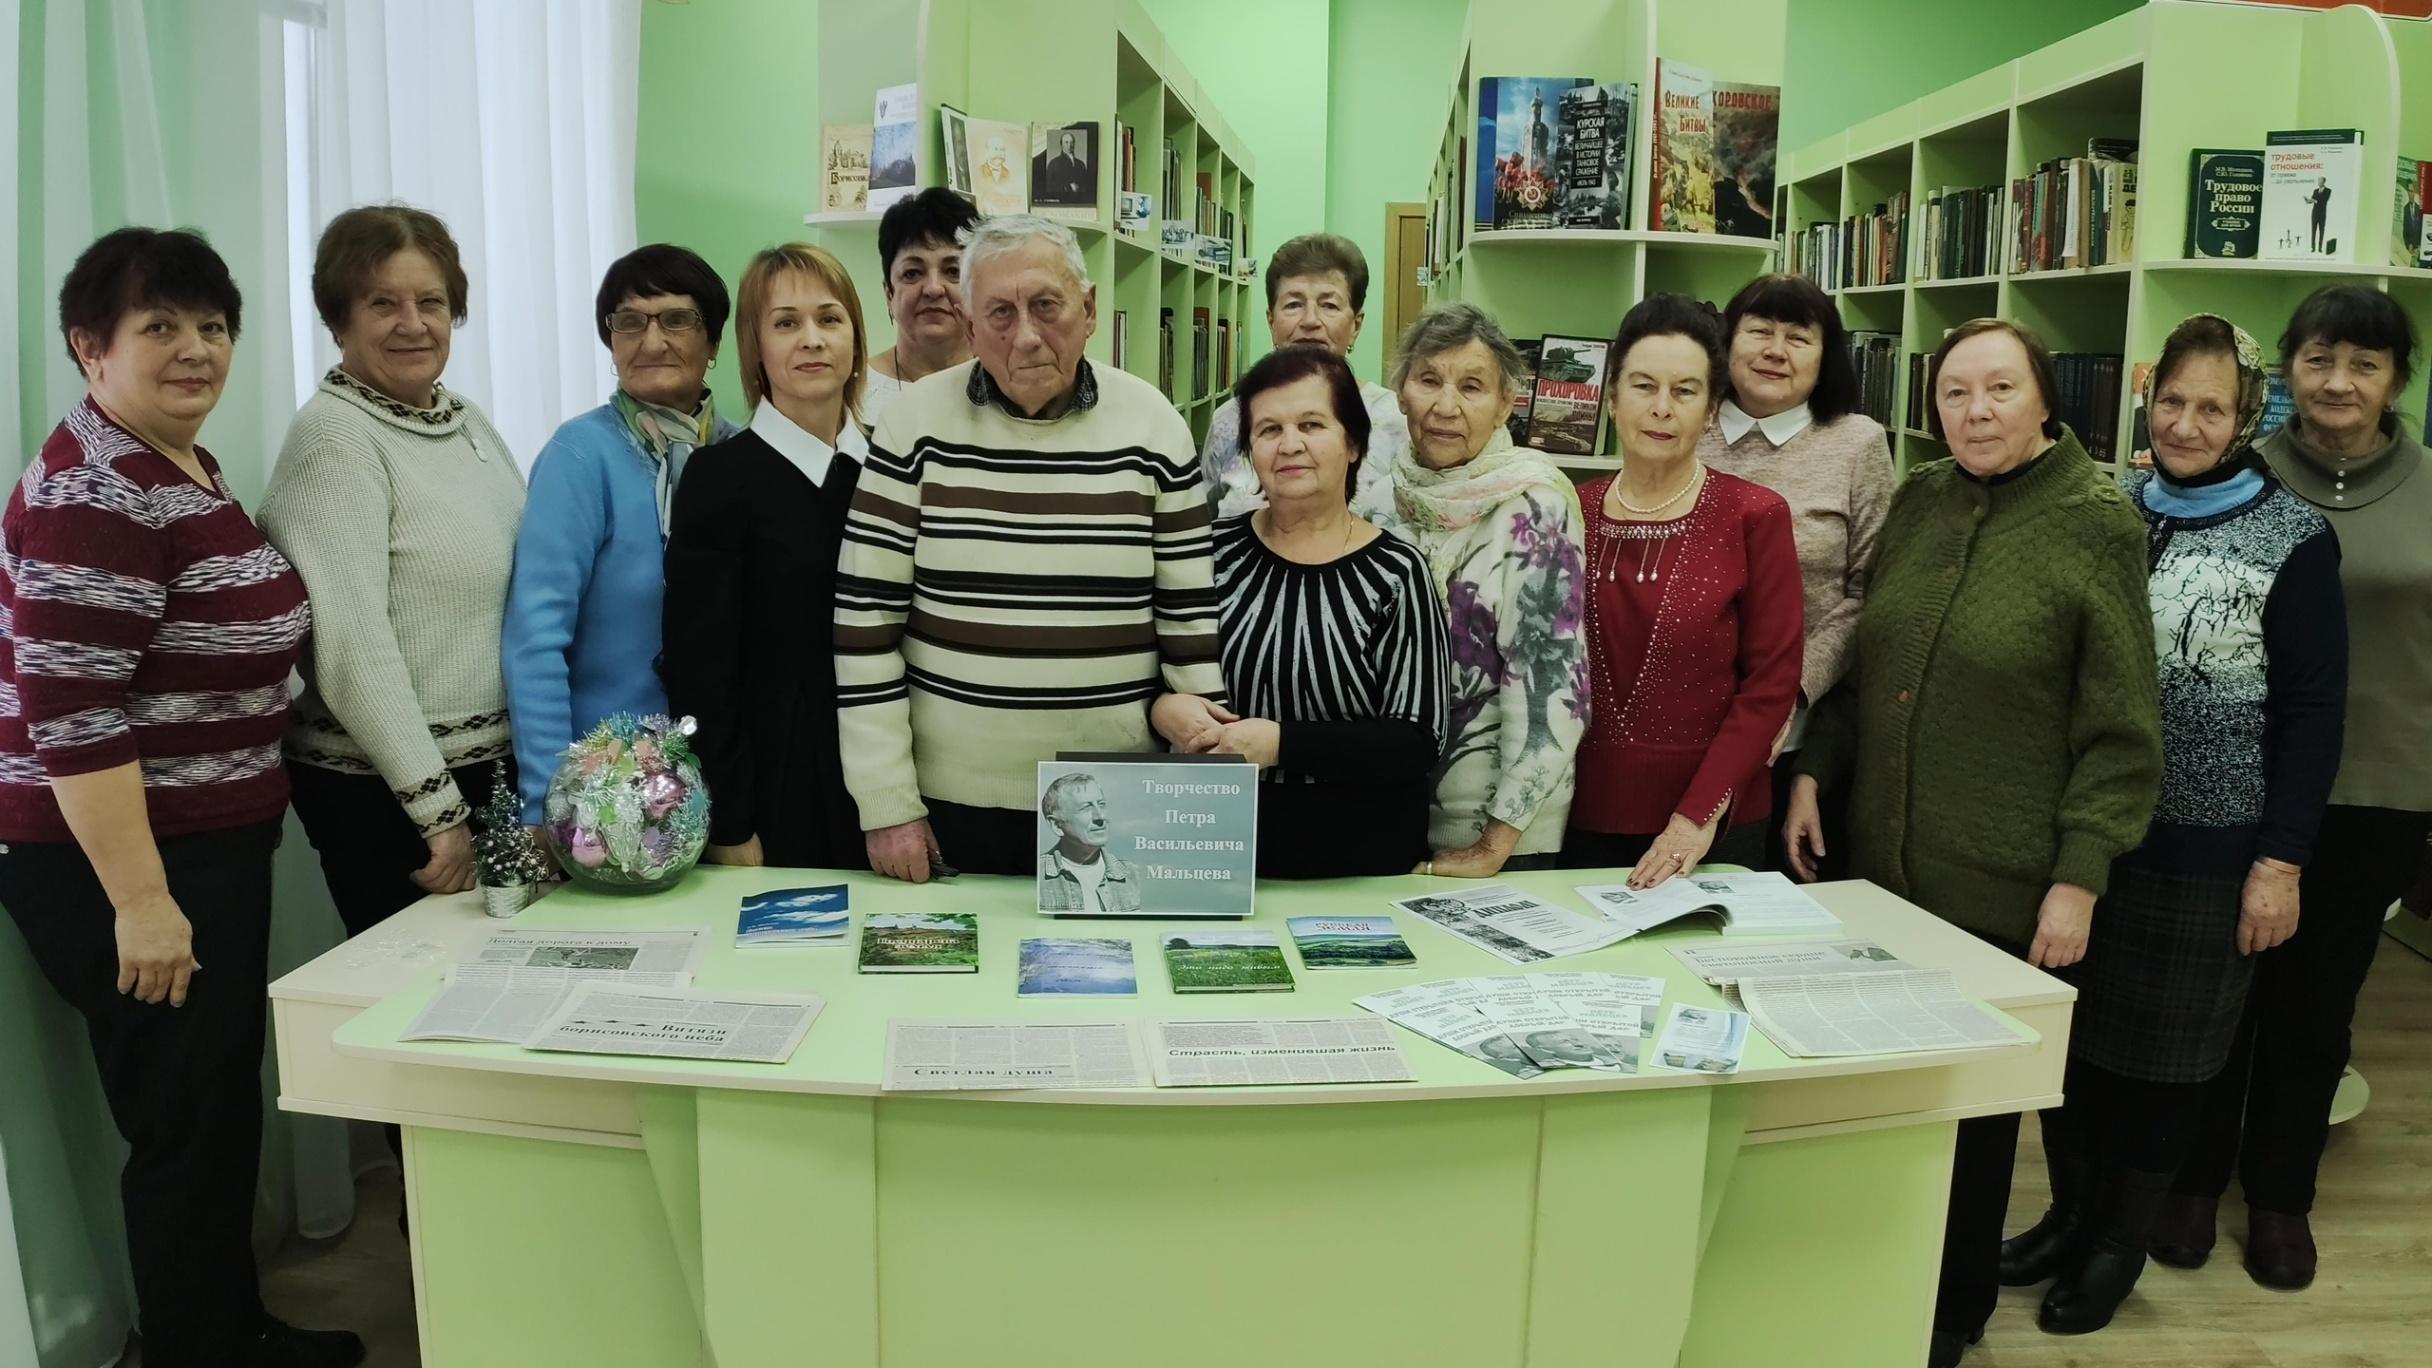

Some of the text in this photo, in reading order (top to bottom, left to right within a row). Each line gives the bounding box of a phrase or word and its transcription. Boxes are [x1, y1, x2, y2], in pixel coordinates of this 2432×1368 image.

[1665, 90, 1699, 109] ВЕЛИКИЕ
[1577, 117, 1605, 129] КУРСКАЯ
[1680, 115, 1707, 132] БИТВЫ
[1580, 128, 1600, 139] БИТВА
[1577, 159, 1599, 167] ТАНКОВОЕ
[2271, 153, 2315, 163] трудовые
[1575, 167, 1599, 176] СРАЖЕНИЕ
[2204, 179, 2264, 194] Трудовое
[2215, 193, 2252, 204] право
[2209, 201, 2255, 213] России
[1538, 381, 1599, 401] ПРОХОРОВКА
[1142, 779, 1240, 798] Творчество
[1164, 809, 1217, 828] Петра
[1134, 836, 1244, 851] Васильевича
[1146, 865, 1232, 880] Мальцева
[1472, 900, 1541, 918] ДИПЛОМ
[559, 1026, 725, 1042] борисовского неба
[662, 1024, 727, 1035] Витязи
[1168, 1045, 1396, 1057] Страсть, изменившая жизнь
[914, 1068, 1053, 1077] Светлая душа
